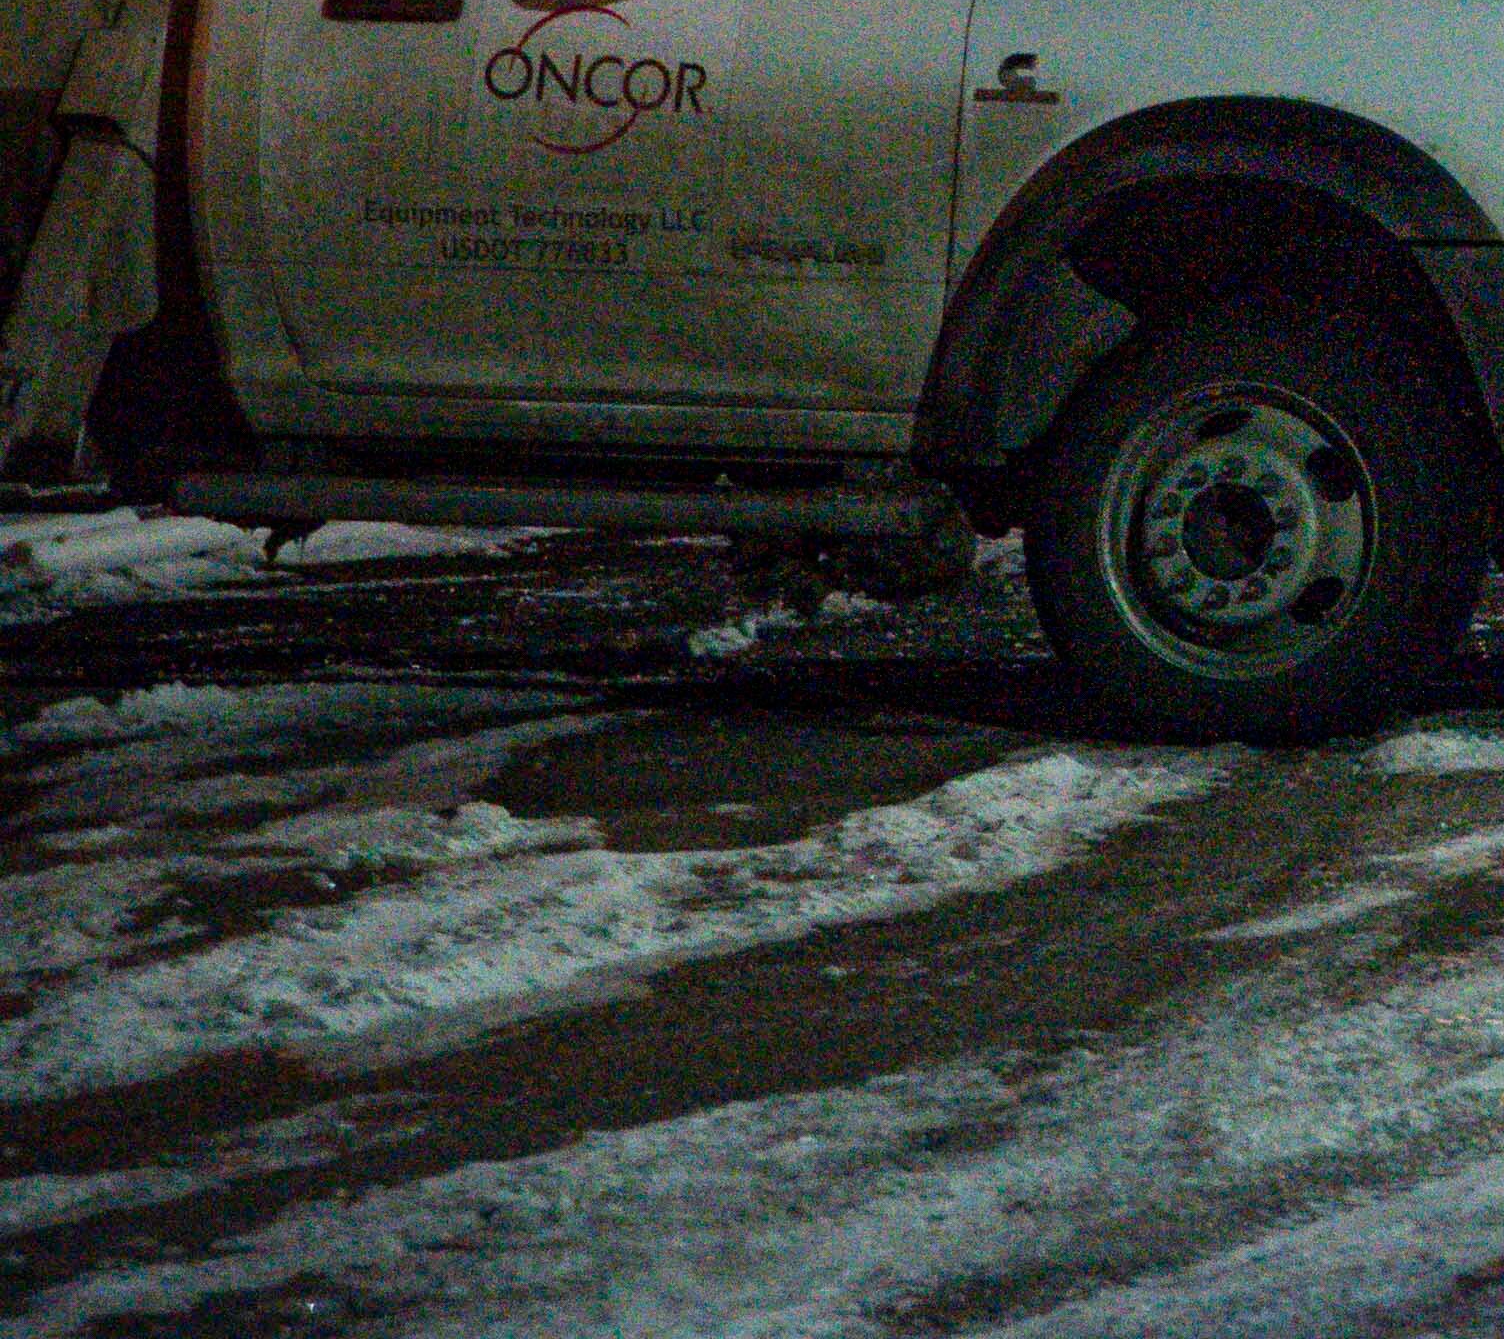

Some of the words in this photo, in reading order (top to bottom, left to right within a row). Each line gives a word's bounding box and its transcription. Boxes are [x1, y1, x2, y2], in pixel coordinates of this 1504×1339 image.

[485, 48, 708, 114] ONCOR
[364, 198, 500, 229] Equipment
[511, 204, 652, 234] Technology
[441, 237, 525, 262] USDOT
